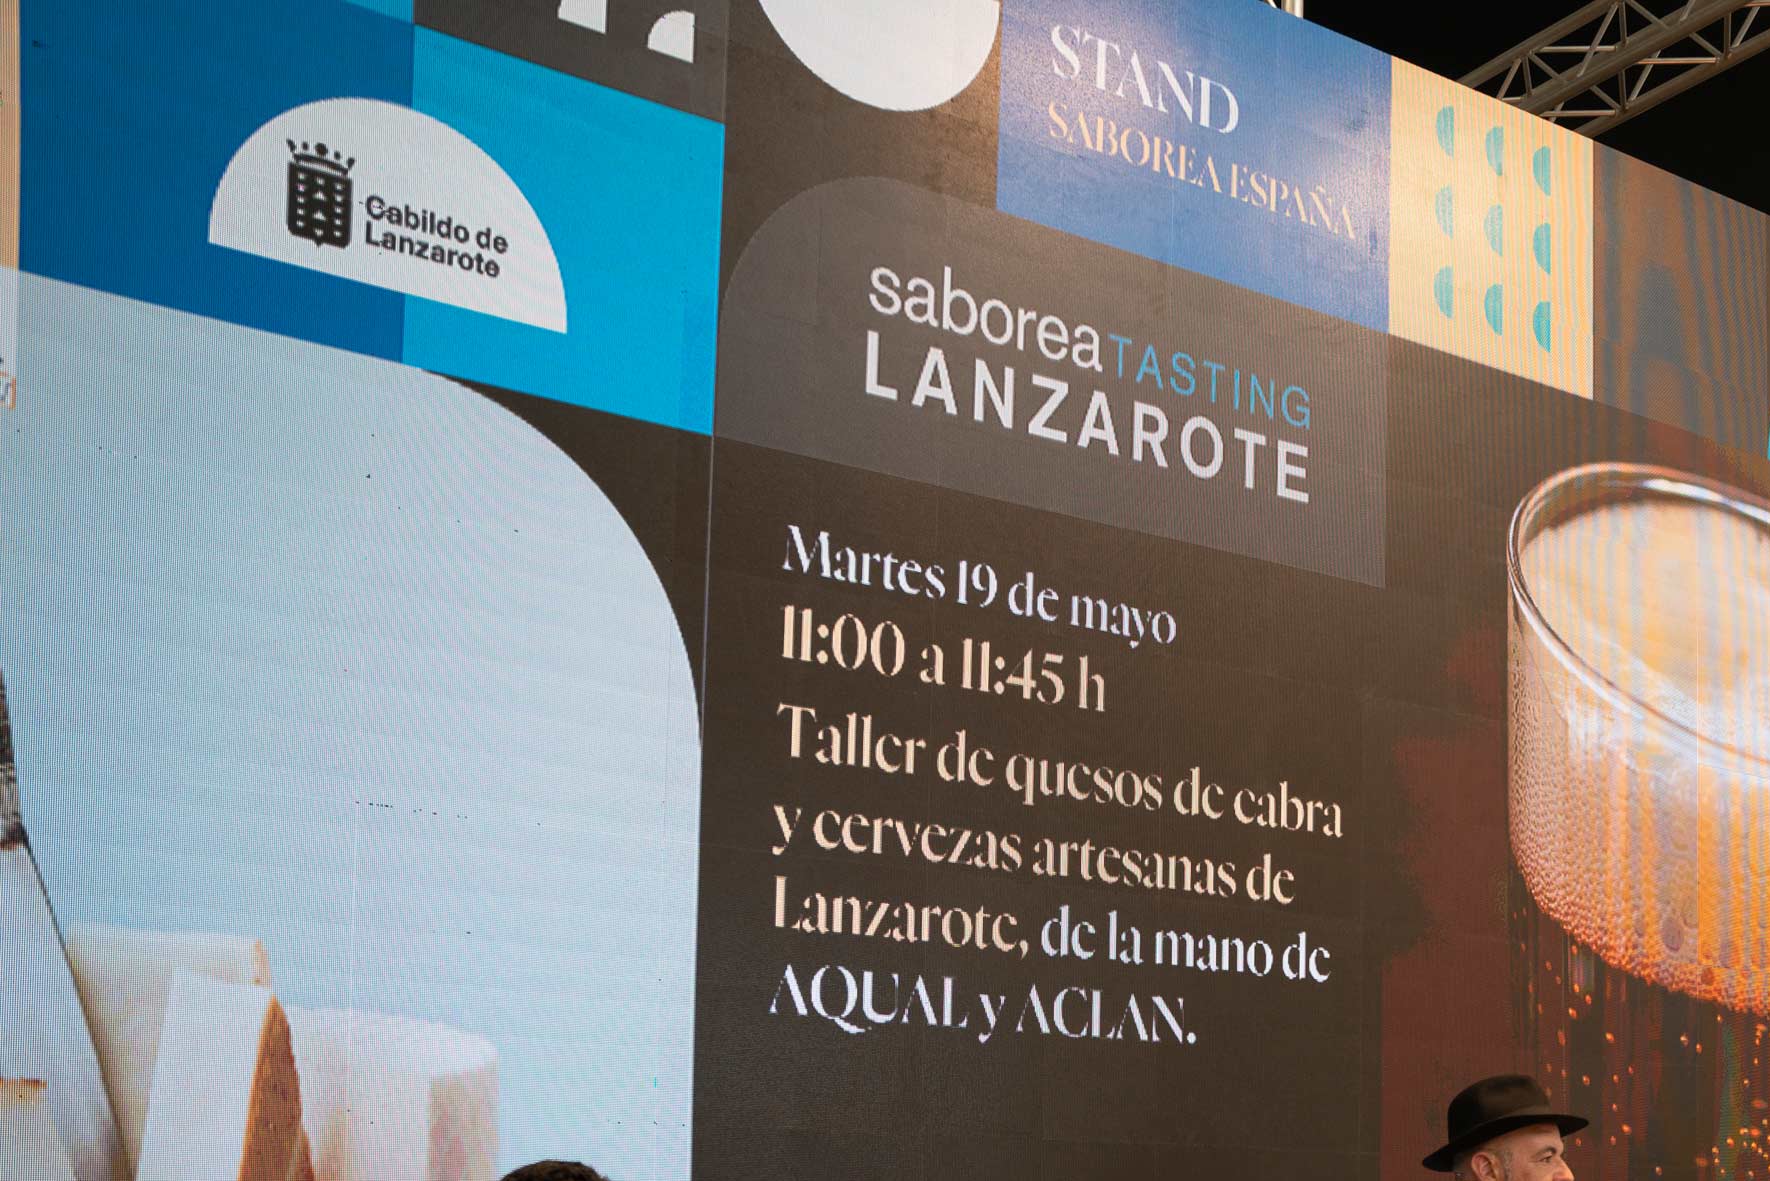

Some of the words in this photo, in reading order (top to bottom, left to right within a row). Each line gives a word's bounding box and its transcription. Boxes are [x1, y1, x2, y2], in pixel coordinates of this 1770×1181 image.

[1053, 25, 1239, 134] STAND
[365, 193, 470, 244] Cabildo
[476, 227, 508, 255] de
[1047, 102, 1221, 193] SABOREA
[1229, 162, 1355, 240] ESPAÑA
[365, 222, 500, 278] Lanzarote
[869, 265, 1101, 373] saborea
[1109, 334, 1311, 429] TASTING
[866, 330, 1309, 503] LANZAROTE
[782, 525, 944, 599] Martes
[958, 560, 997, 609] 19
[1009, 573, 1058, 621] de
[1071, 594, 1177, 648] mayo
[781, 605, 905, 677] 11:00
[920, 646, 943, 685] a
[962, 639, 1064, 703] 11:45
[1079, 656, 1105, 712] h
[777, 703, 926, 775] Taller
[937, 730, 994, 785] de
[1006, 753, 1162, 811] quesos
[1173, 767, 1223, 818] de
[1233, 780, 1342, 838] cabra
[772, 805, 802, 855] y
[813, 806, 1021, 871] cervezas
[1032, 838, 1236, 896] artesanas
[1247, 854, 1294, 904] de
[774, 875, 1028, 956] Lanzarote,
[1041, 905, 1095, 959] de
[1109, 910, 1142, 963] la
[1156, 935, 1273, 975] mano
[1282, 932, 1330, 982] de
[770, 964, 967, 1033] AQUAL
[977, 992, 1005, 1042] y
[1016, 986, 1198, 1043] ACLAN.
